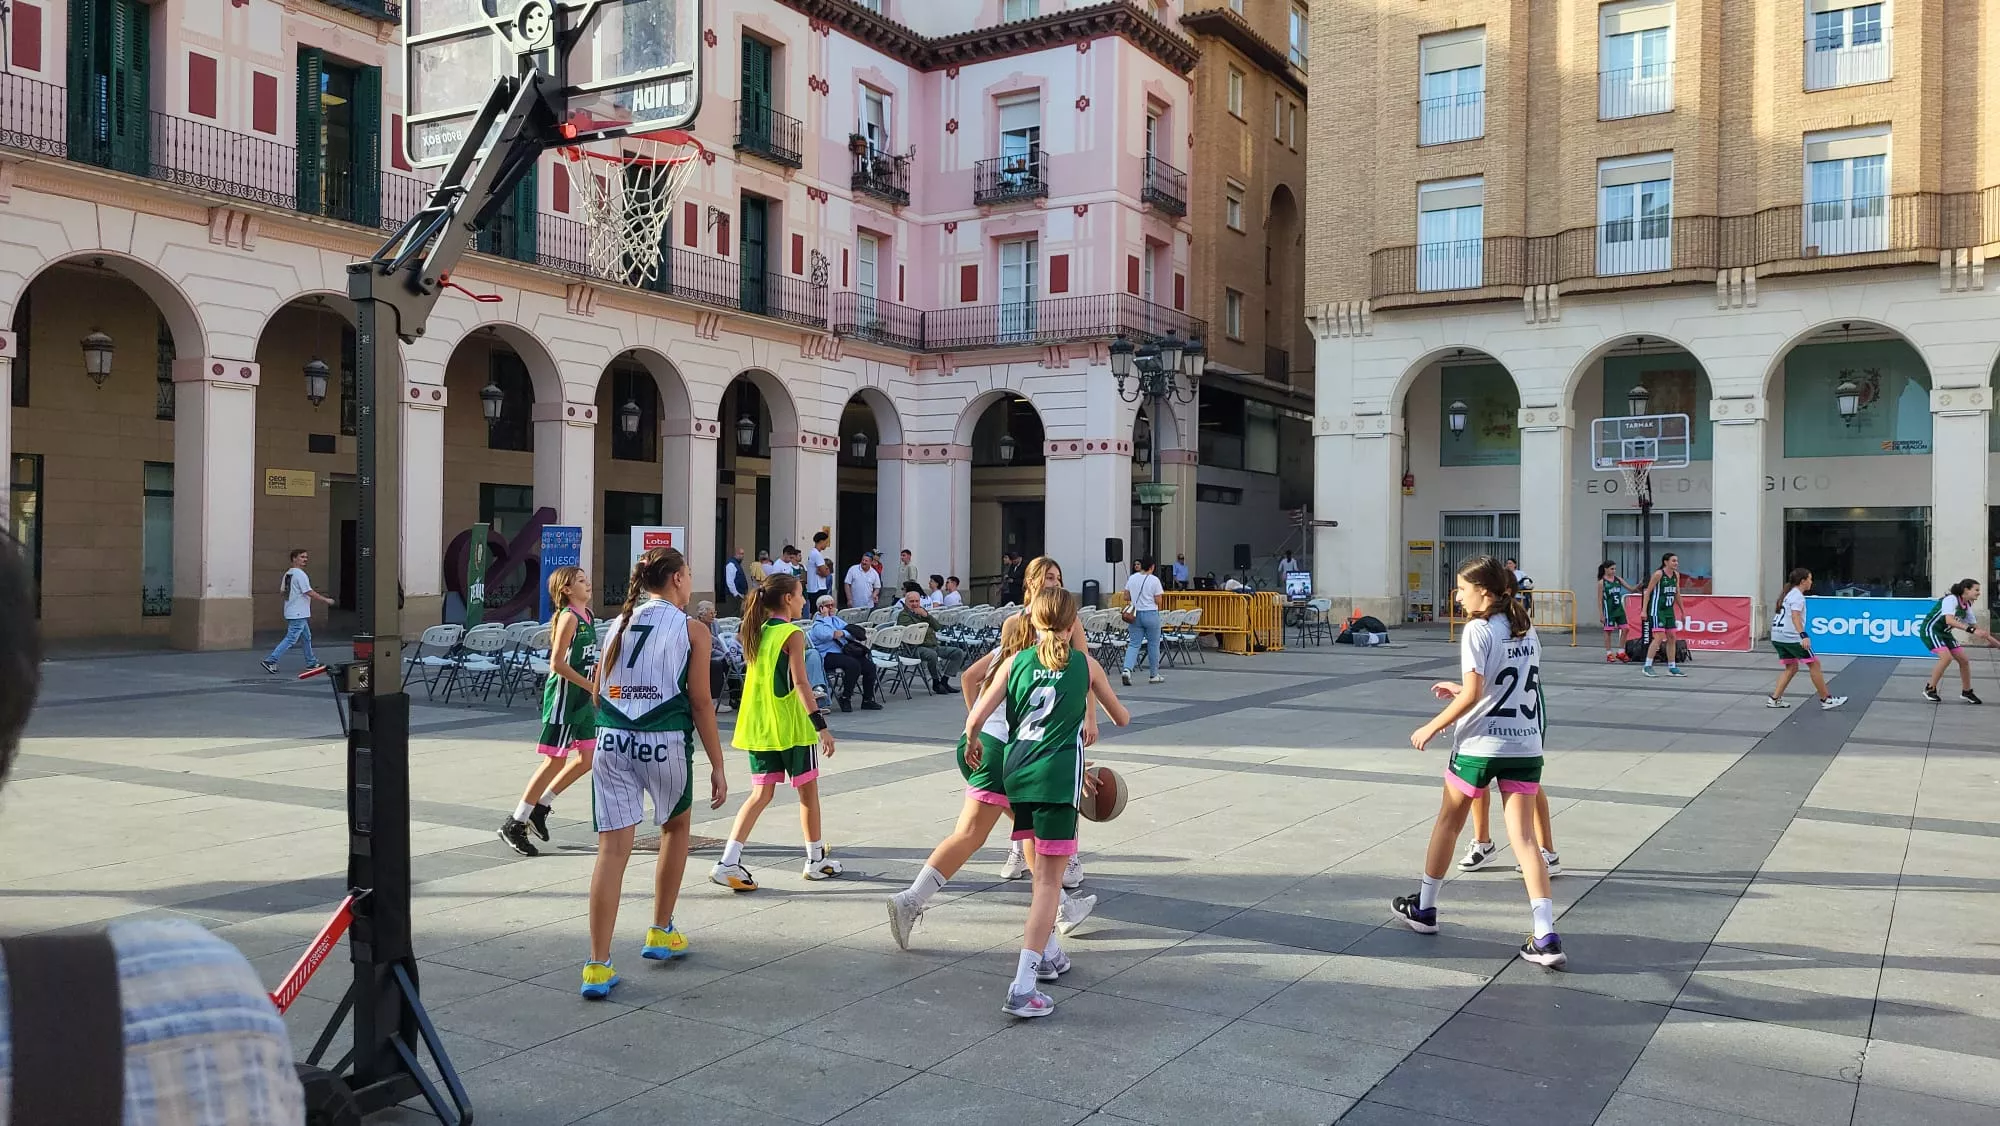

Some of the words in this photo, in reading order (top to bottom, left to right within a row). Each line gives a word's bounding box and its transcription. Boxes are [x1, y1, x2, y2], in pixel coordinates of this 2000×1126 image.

[1625, 421, 1654, 429] TARMAK
[1614, 595, 1620, 604] 5
[626, 624, 655, 669] 7
[1507, 645, 1535, 659] EMMA
[621, 685, 658, 693] GOBIERNO
[1485, 665, 1539, 720] 25
[1016, 685, 1057, 742] 2
